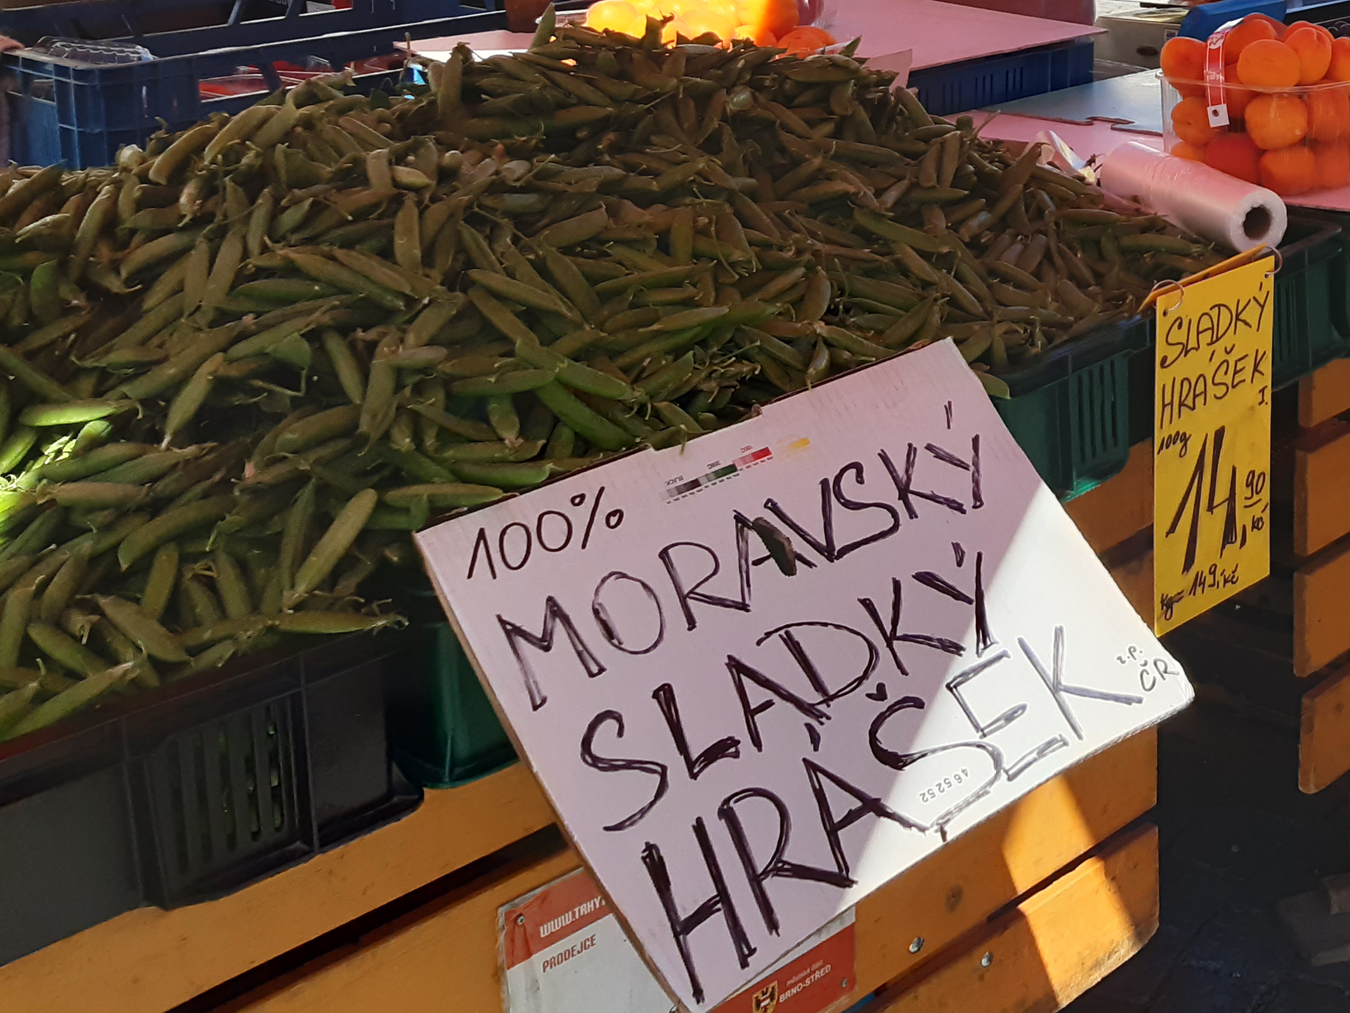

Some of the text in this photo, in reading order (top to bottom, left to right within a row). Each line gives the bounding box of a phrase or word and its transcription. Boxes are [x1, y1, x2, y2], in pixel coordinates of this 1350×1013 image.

[1160, 281, 1270, 369] SLADKÝ
[1160, 344, 1267, 430] HRÁŠEK
[1157, 430, 1192, 459] 100g
[1244, 470, 1266, 501] 90
[467, 486, 625, 580] 100%
[496, 400, 985, 712] MORAVSKÝ
[580, 542, 999, 832] SLADKÝ
[1139, 657, 1181, 692] ČR
[641, 624, 1144, 1004] HRÁŠEK
[918, 766, 970, 804] 465252
[542, 933, 597, 974] PRODEJCE
[779, 963, 832, 1004] BRNO-STŘED
